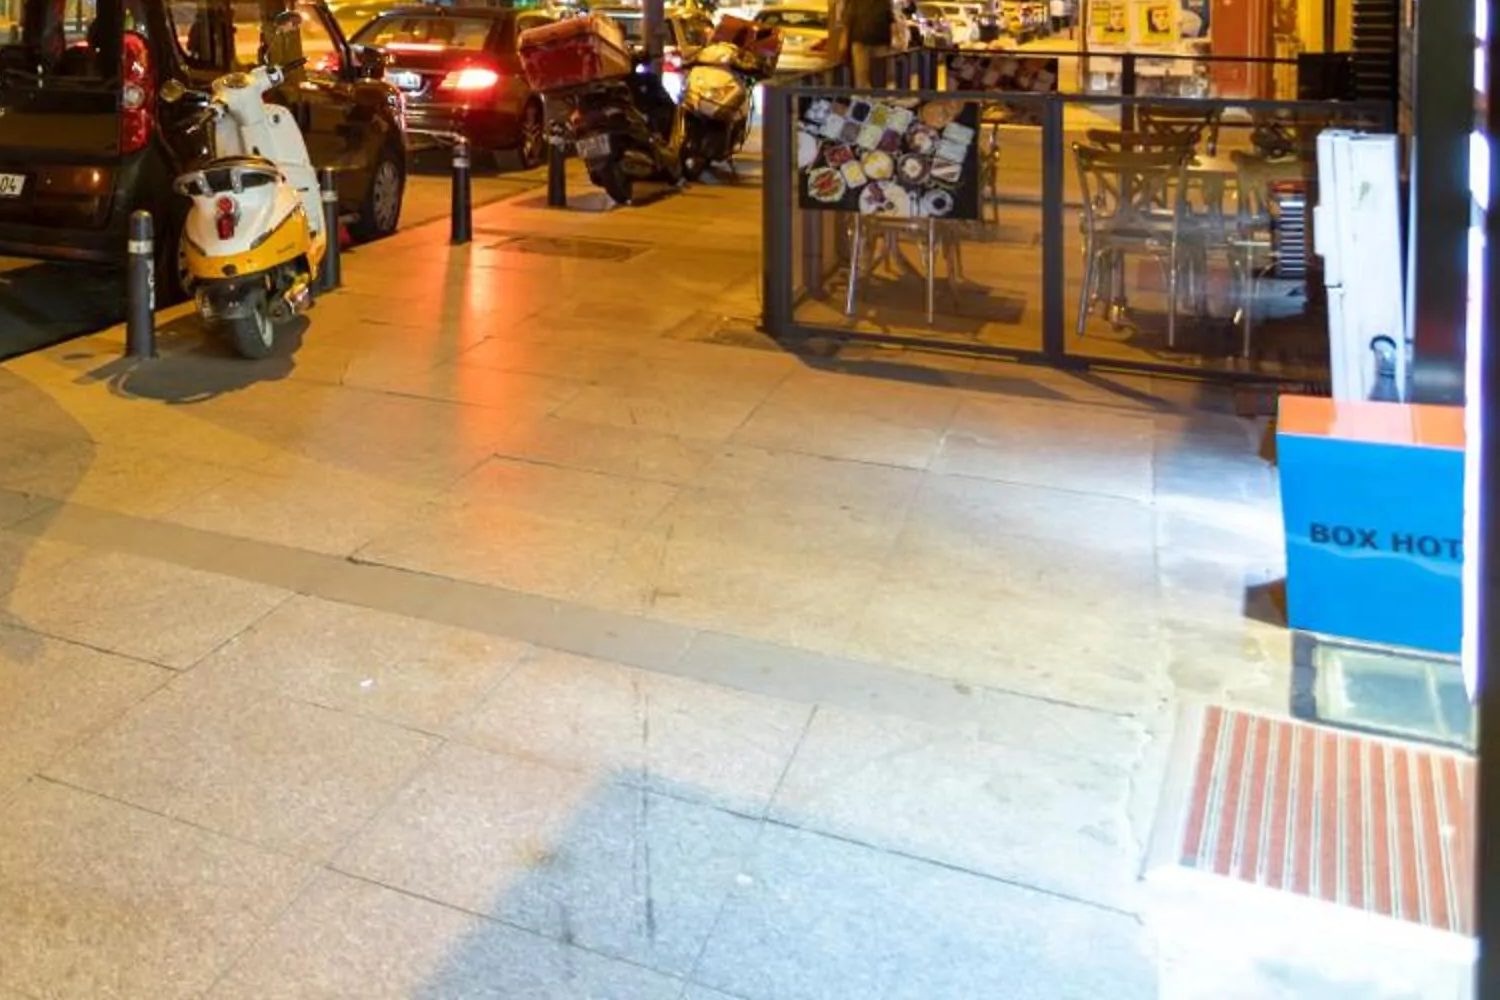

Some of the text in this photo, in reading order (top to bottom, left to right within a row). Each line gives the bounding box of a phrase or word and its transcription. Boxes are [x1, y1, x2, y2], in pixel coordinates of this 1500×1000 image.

[0, 174, 17, 192] 04
[1309, 522, 1463, 559] BOX HOT
